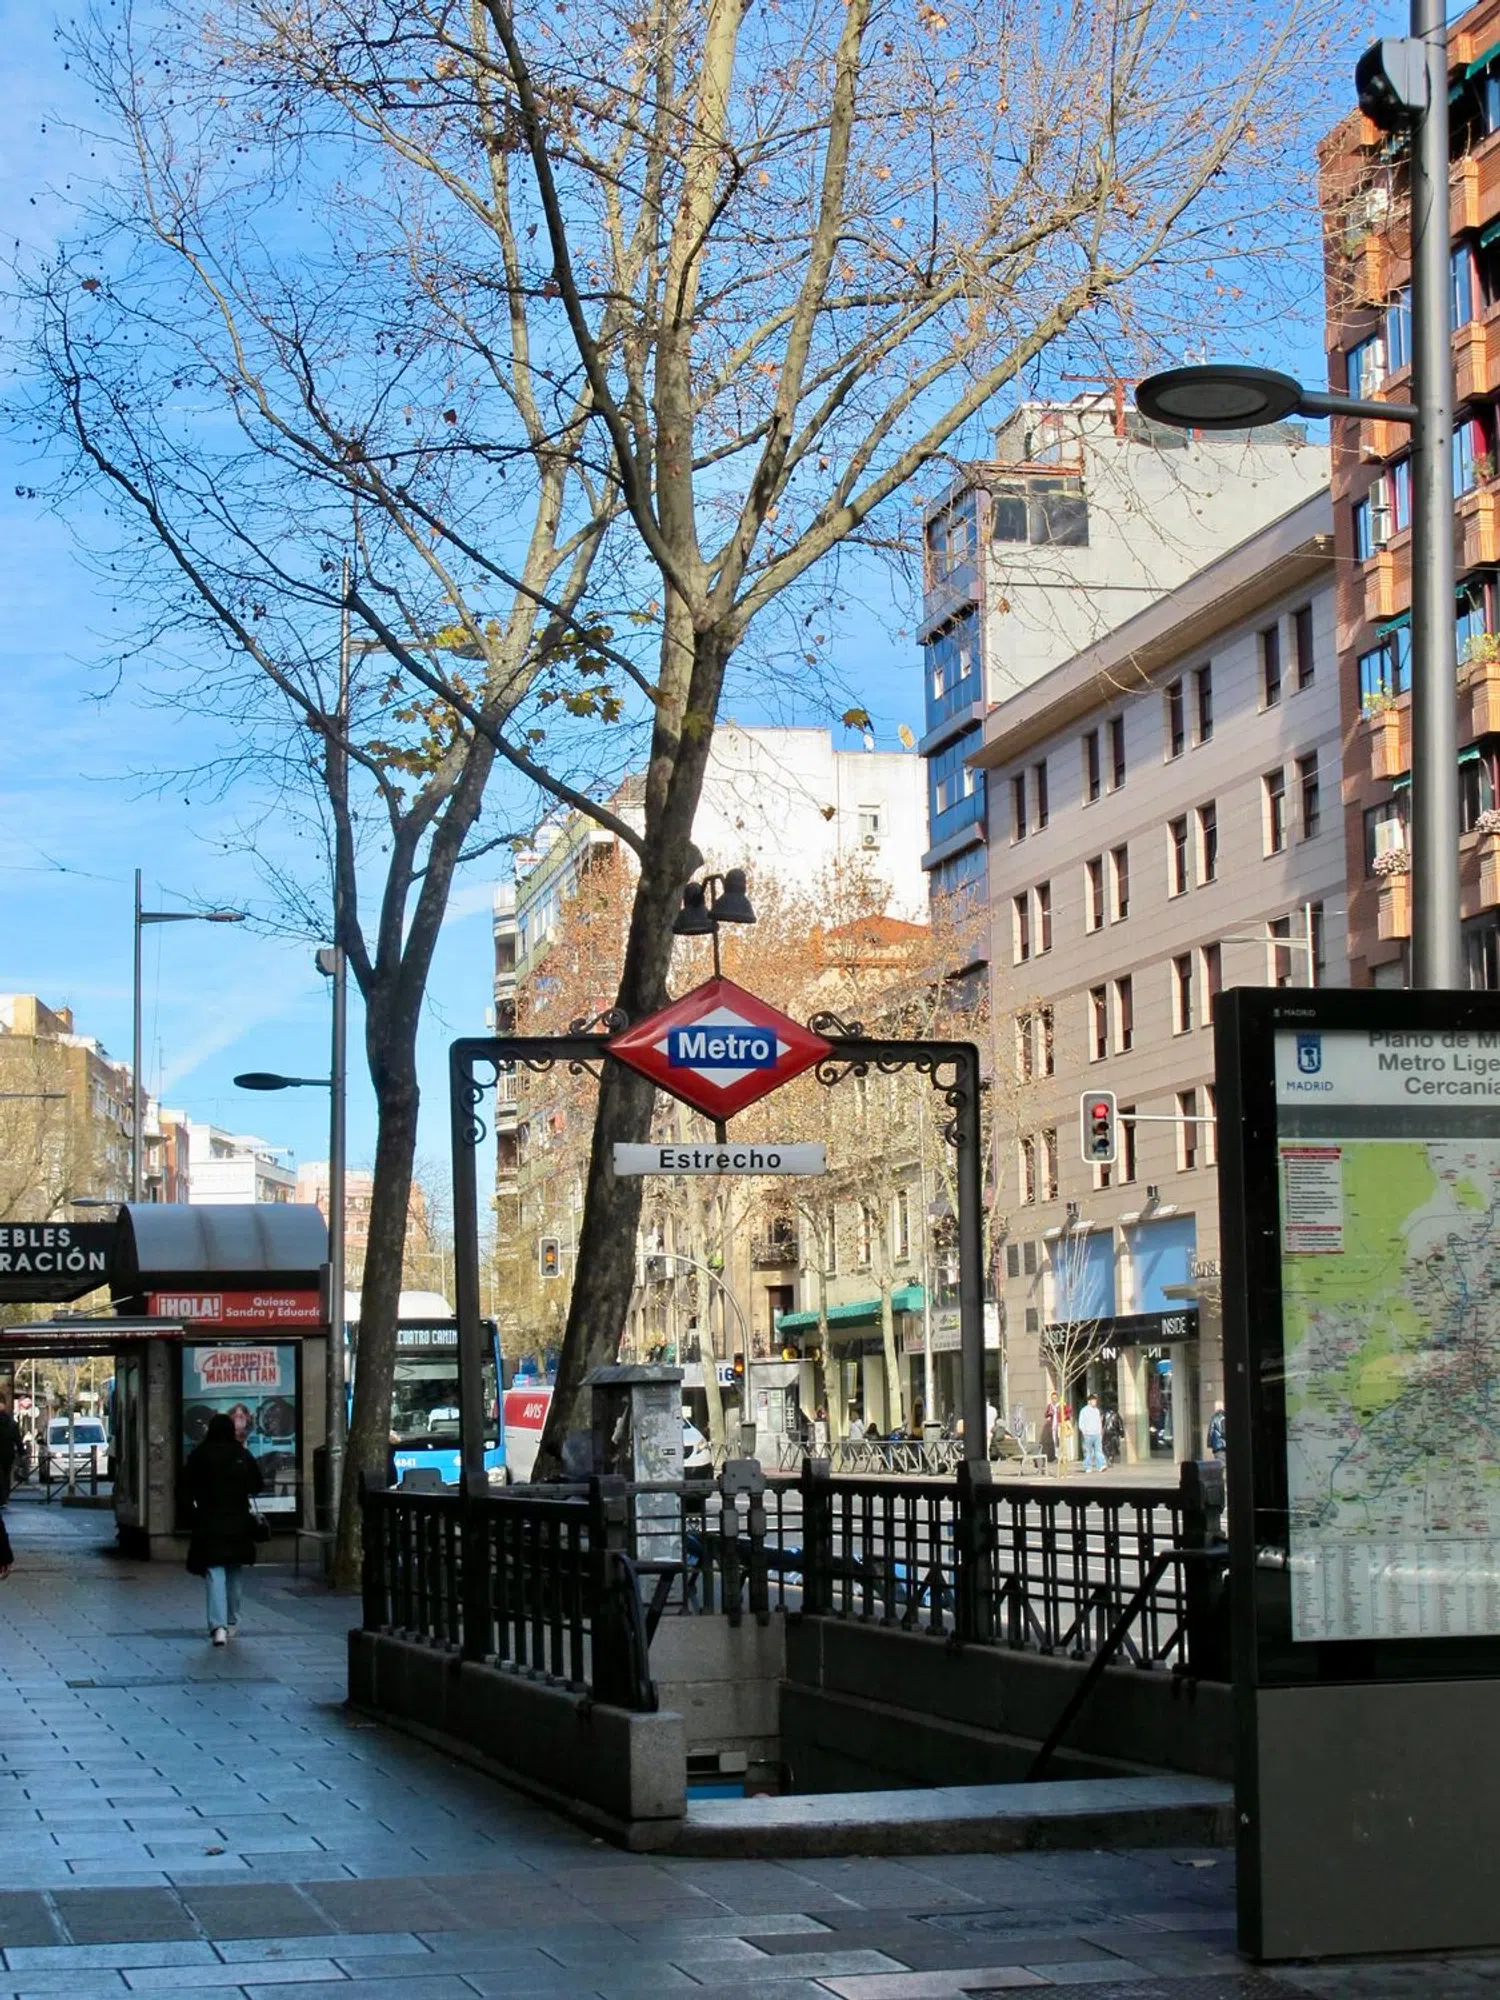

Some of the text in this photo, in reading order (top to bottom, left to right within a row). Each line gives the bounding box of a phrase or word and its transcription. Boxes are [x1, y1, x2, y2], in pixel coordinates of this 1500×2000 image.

[1283, 1009, 1317, 1017] MADRID
[678, 1032, 770, 1060] Metro
[1368, 1030, 1500, 1049] Plano de M
[1378, 1053, 1500, 1076] Metro Lige
[1286, 1080, 1334, 1092] MADRID
[1404, 1076, 1500, 1096] Cercanía
[659, 1149, 782, 1169] Estrecho
[0, 1228, 71, 1247] EBLES
[0, 1246, 106, 1271] RACIÓN
[159, 1297, 220, 1318] ¡HOLA!
[253, 1297, 296, 1307] Quiosco
[226, 1307, 266, 1318] Sandra
[268, 1309, 275, 1319] y
[1161, 1316, 1187, 1335] INSIDE
[397, 1329, 430, 1345] CUATRO
[206, 1367, 277, 1384] MANHATTAN
[522, 1402, 543, 1419] AVIS
